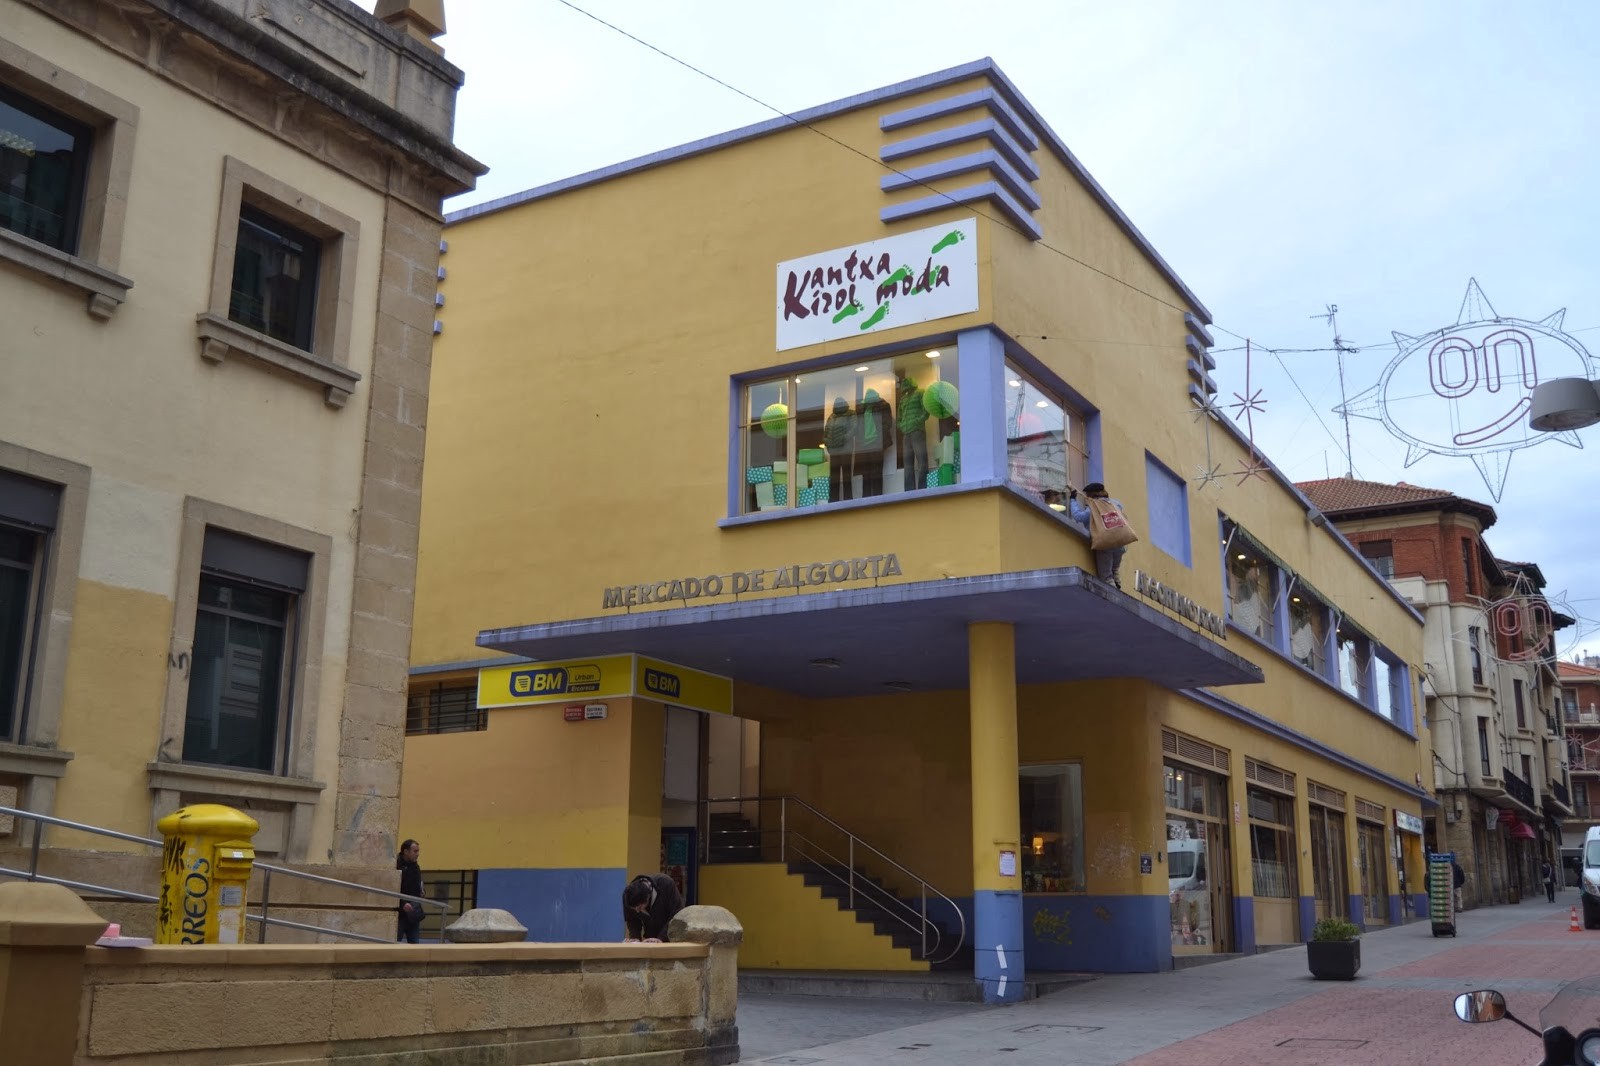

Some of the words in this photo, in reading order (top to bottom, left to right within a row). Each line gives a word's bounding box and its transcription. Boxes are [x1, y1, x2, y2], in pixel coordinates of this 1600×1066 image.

[876, 257, 950, 306] moda
[603, 575, 723, 609] MERCADO
[732, 569, 765, 593] DE
[773, 553, 902, 588] ALGORTA
[533, 672, 563, 692] BM
[574, 673, 595, 681] Urban
[659, 676, 678, 694] BM
